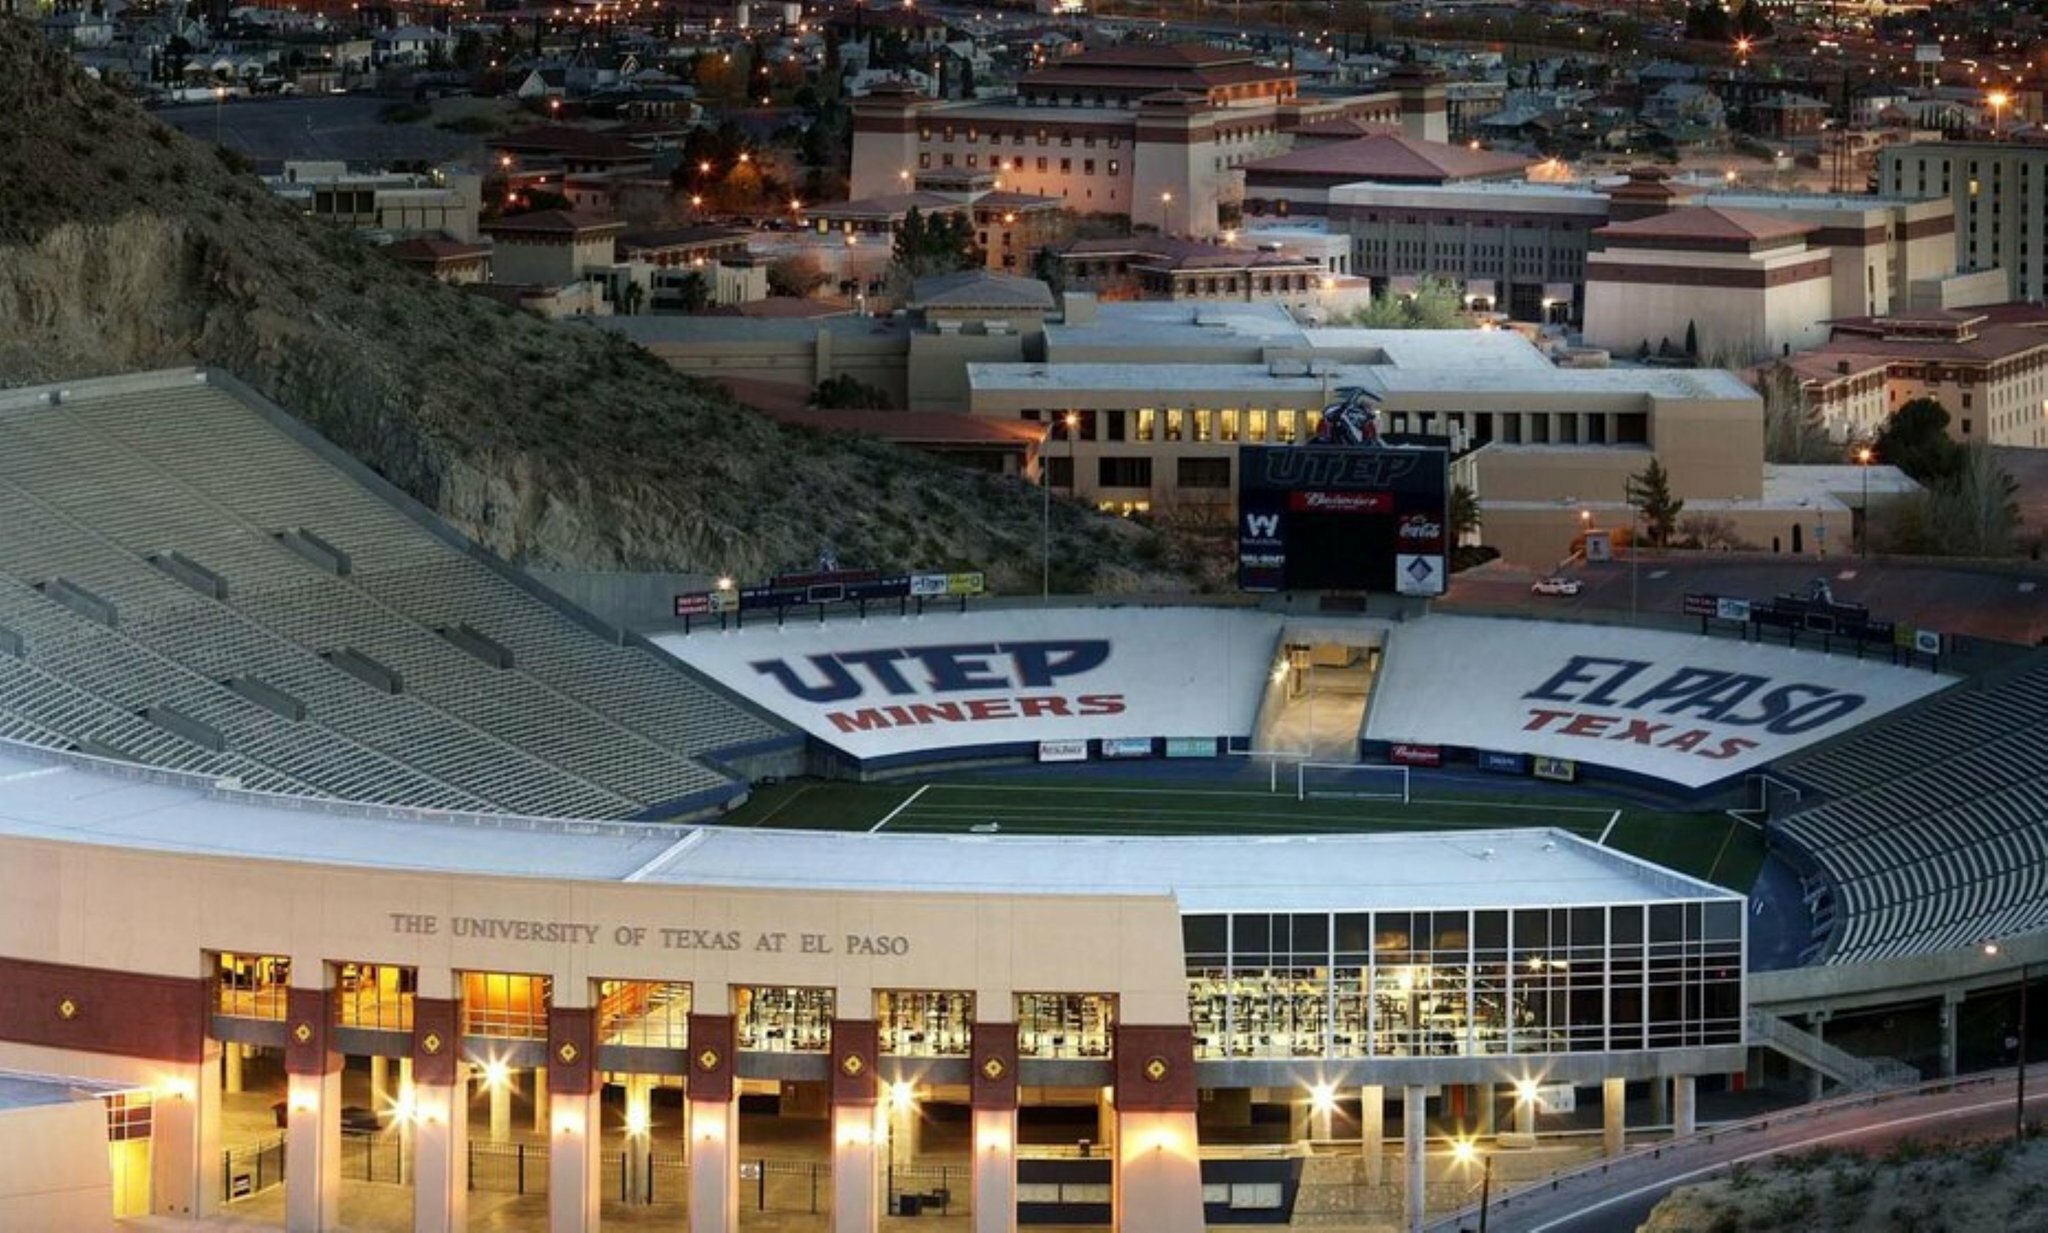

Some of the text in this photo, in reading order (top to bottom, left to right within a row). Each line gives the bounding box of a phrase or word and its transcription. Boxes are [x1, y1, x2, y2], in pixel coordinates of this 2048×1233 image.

[1267, 451, 1420, 486] UTEP
[750, 639, 1109, 703] UTEP
[825, 694, 1126, 733] MINERS
[1522, 655, 1867, 735] EL PASO
[1522, 709, 1760, 760] TEXAS
[390, 913, 909, 956] THE UNIVERSITY OF TEXAS AT EL PASO
